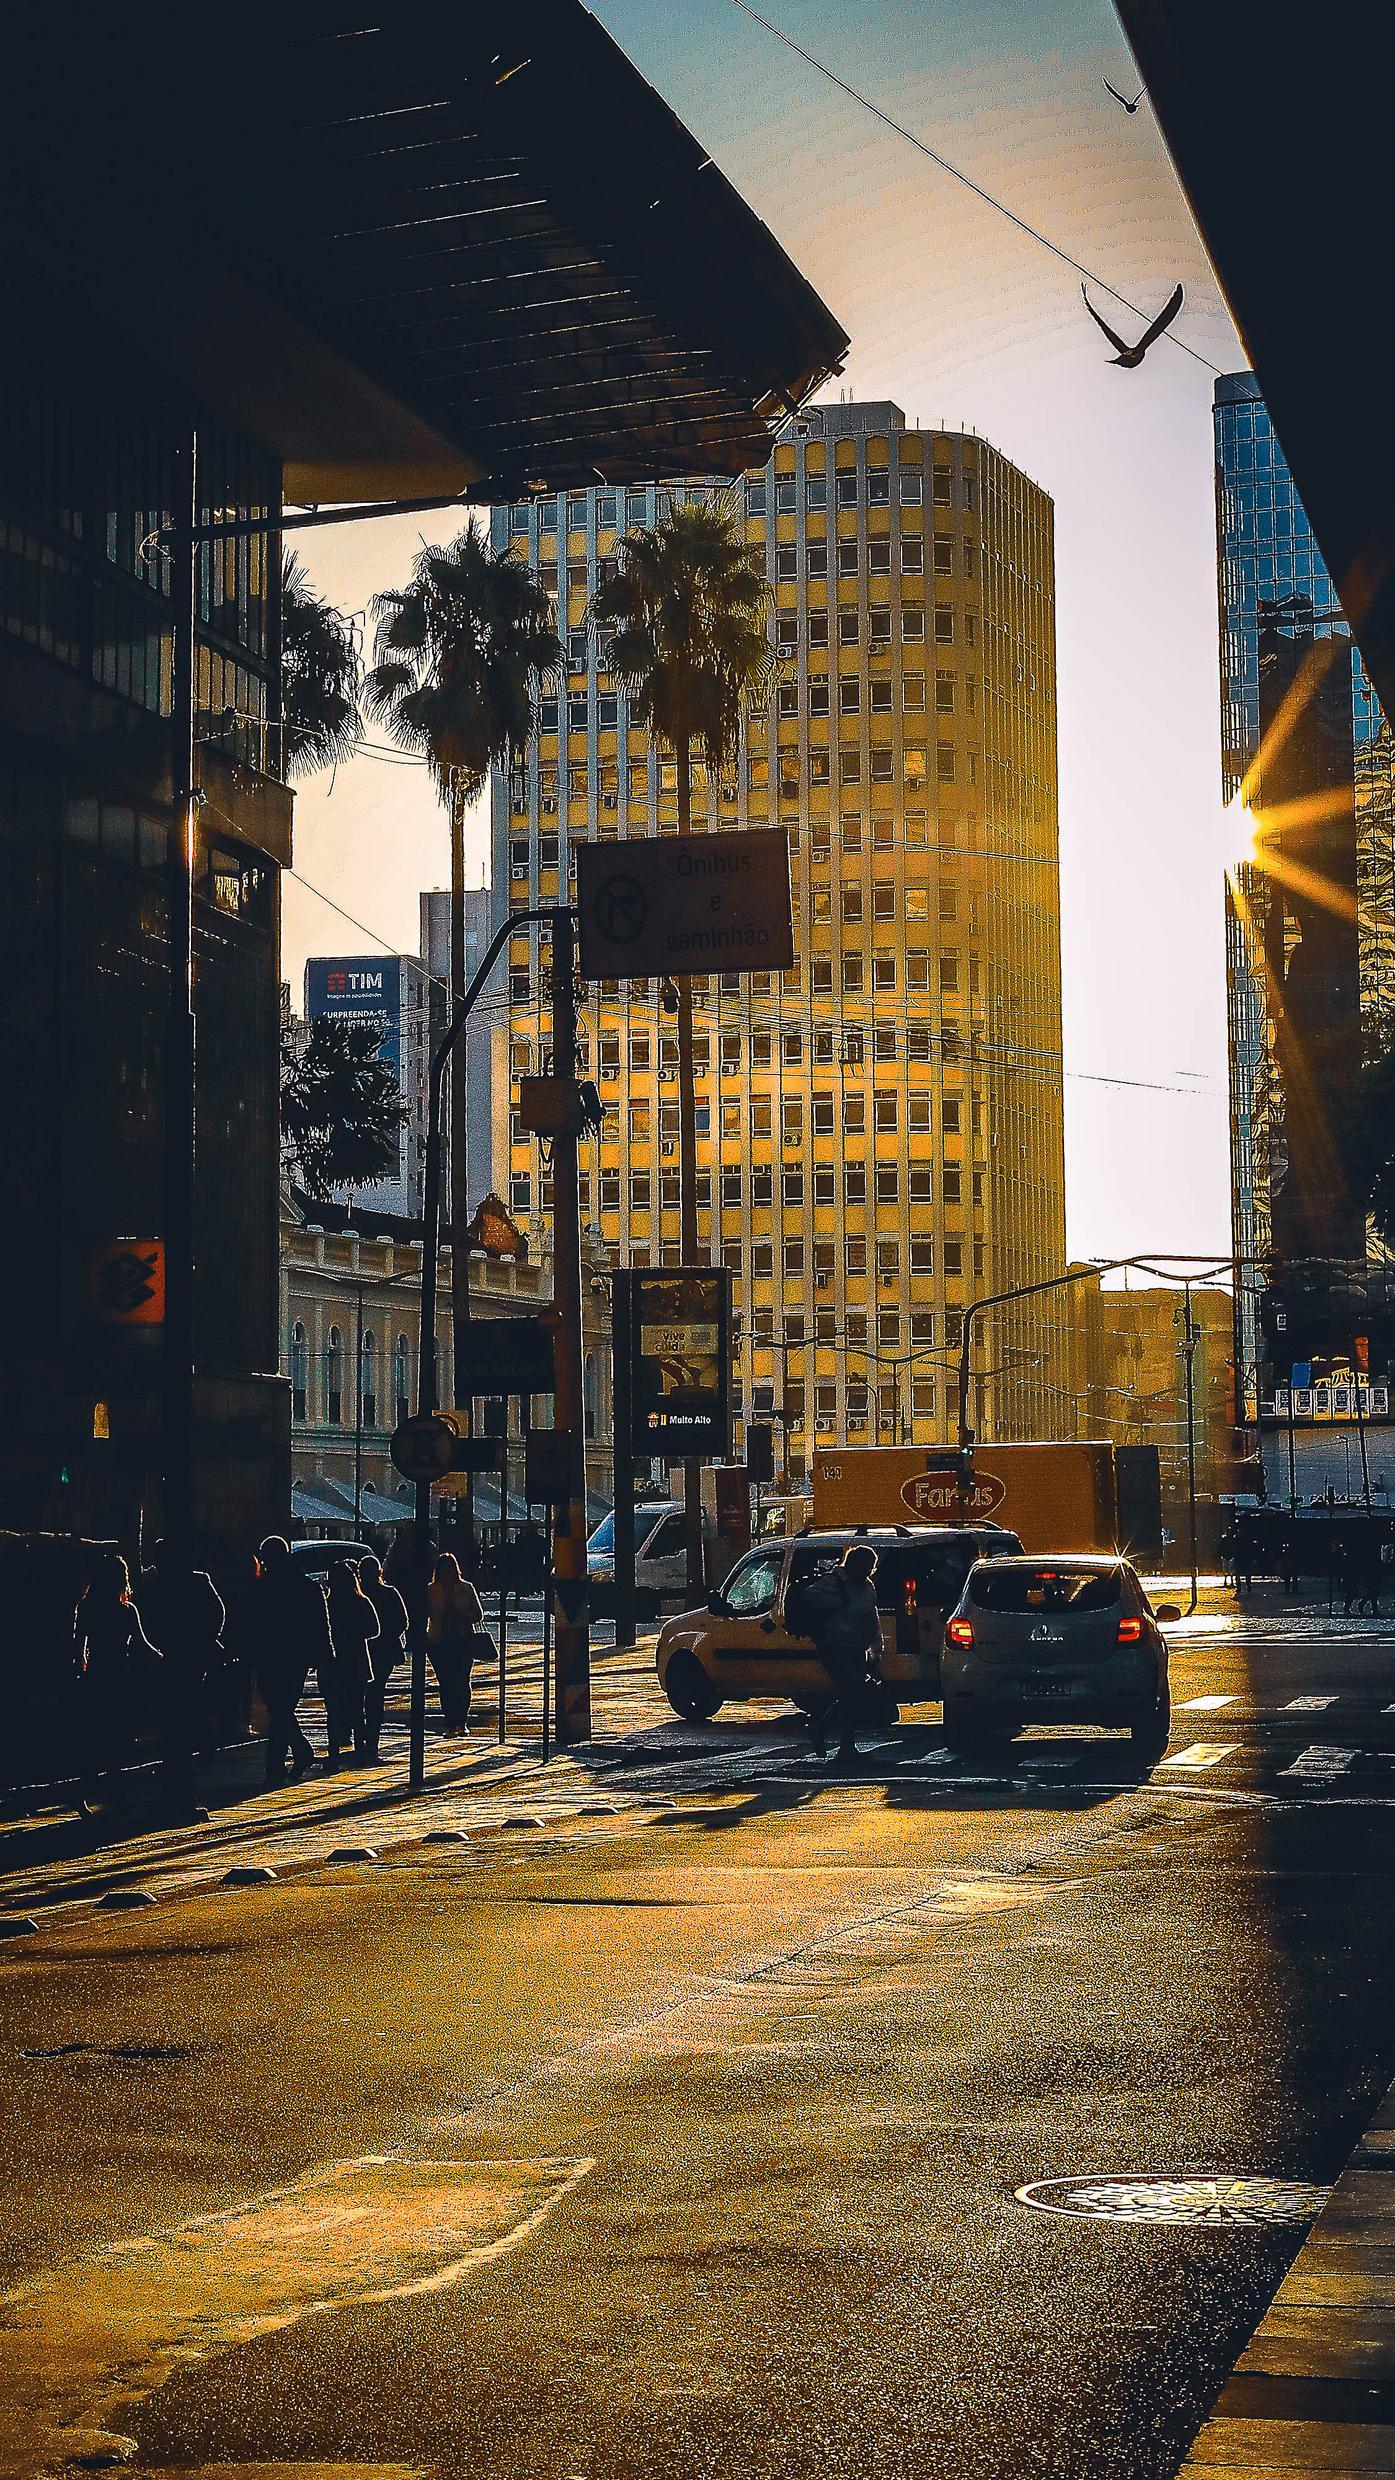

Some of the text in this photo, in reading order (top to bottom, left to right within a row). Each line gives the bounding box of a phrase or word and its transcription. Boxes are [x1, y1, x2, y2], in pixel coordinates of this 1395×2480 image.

[677, 846, 752, 876] Ônibus
[709, 893, 722, 911] e
[667, 922, 769, 950] caminhão
[348, 972, 382, 990] TIM
[669, 1415, 693, 1425] Muito
[694, 1415, 712, 1425] Alto
